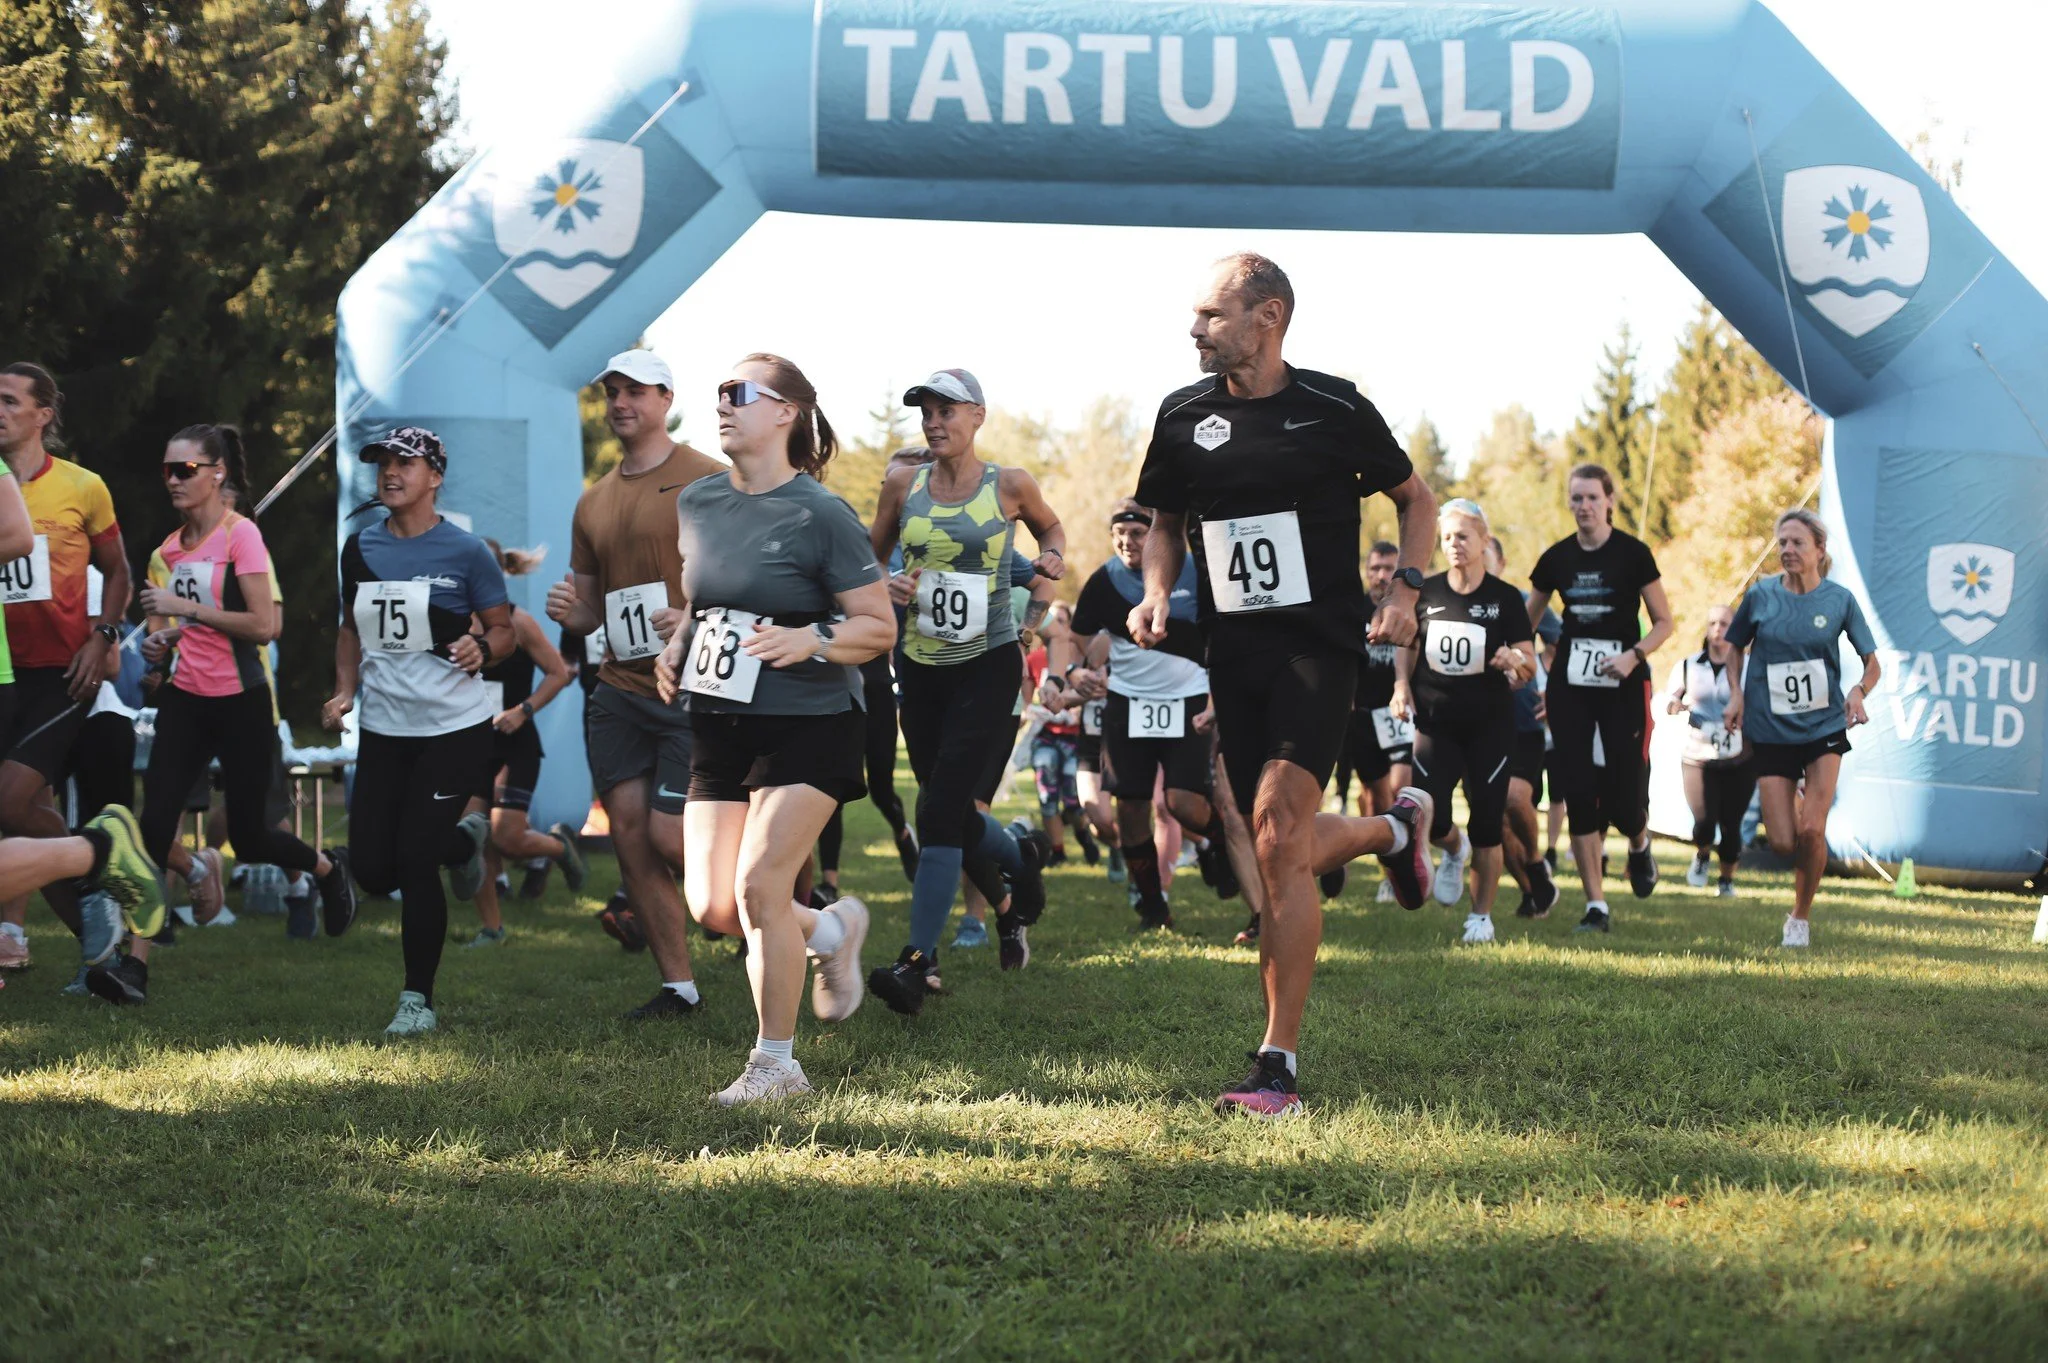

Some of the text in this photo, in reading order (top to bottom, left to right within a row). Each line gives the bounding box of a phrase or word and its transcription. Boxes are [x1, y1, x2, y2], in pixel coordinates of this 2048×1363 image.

[843, 28, 1596, 135] TARTU VALD
[1228, 538, 1280, 593] 49
[372, 599, 408, 640] 75
[620, 603, 648, 646] 11
[932, 588, 968, 630] 89
[697, 627, 740, 680] 68
[1440, 636, 1471, 665] 90
[1785, 674, 1813, 703] 91
[1876, 649, 2037, 704] TARTU
[1142, 704, 1171, 729] 30
[1888, 695, 2025, 748] VALD
